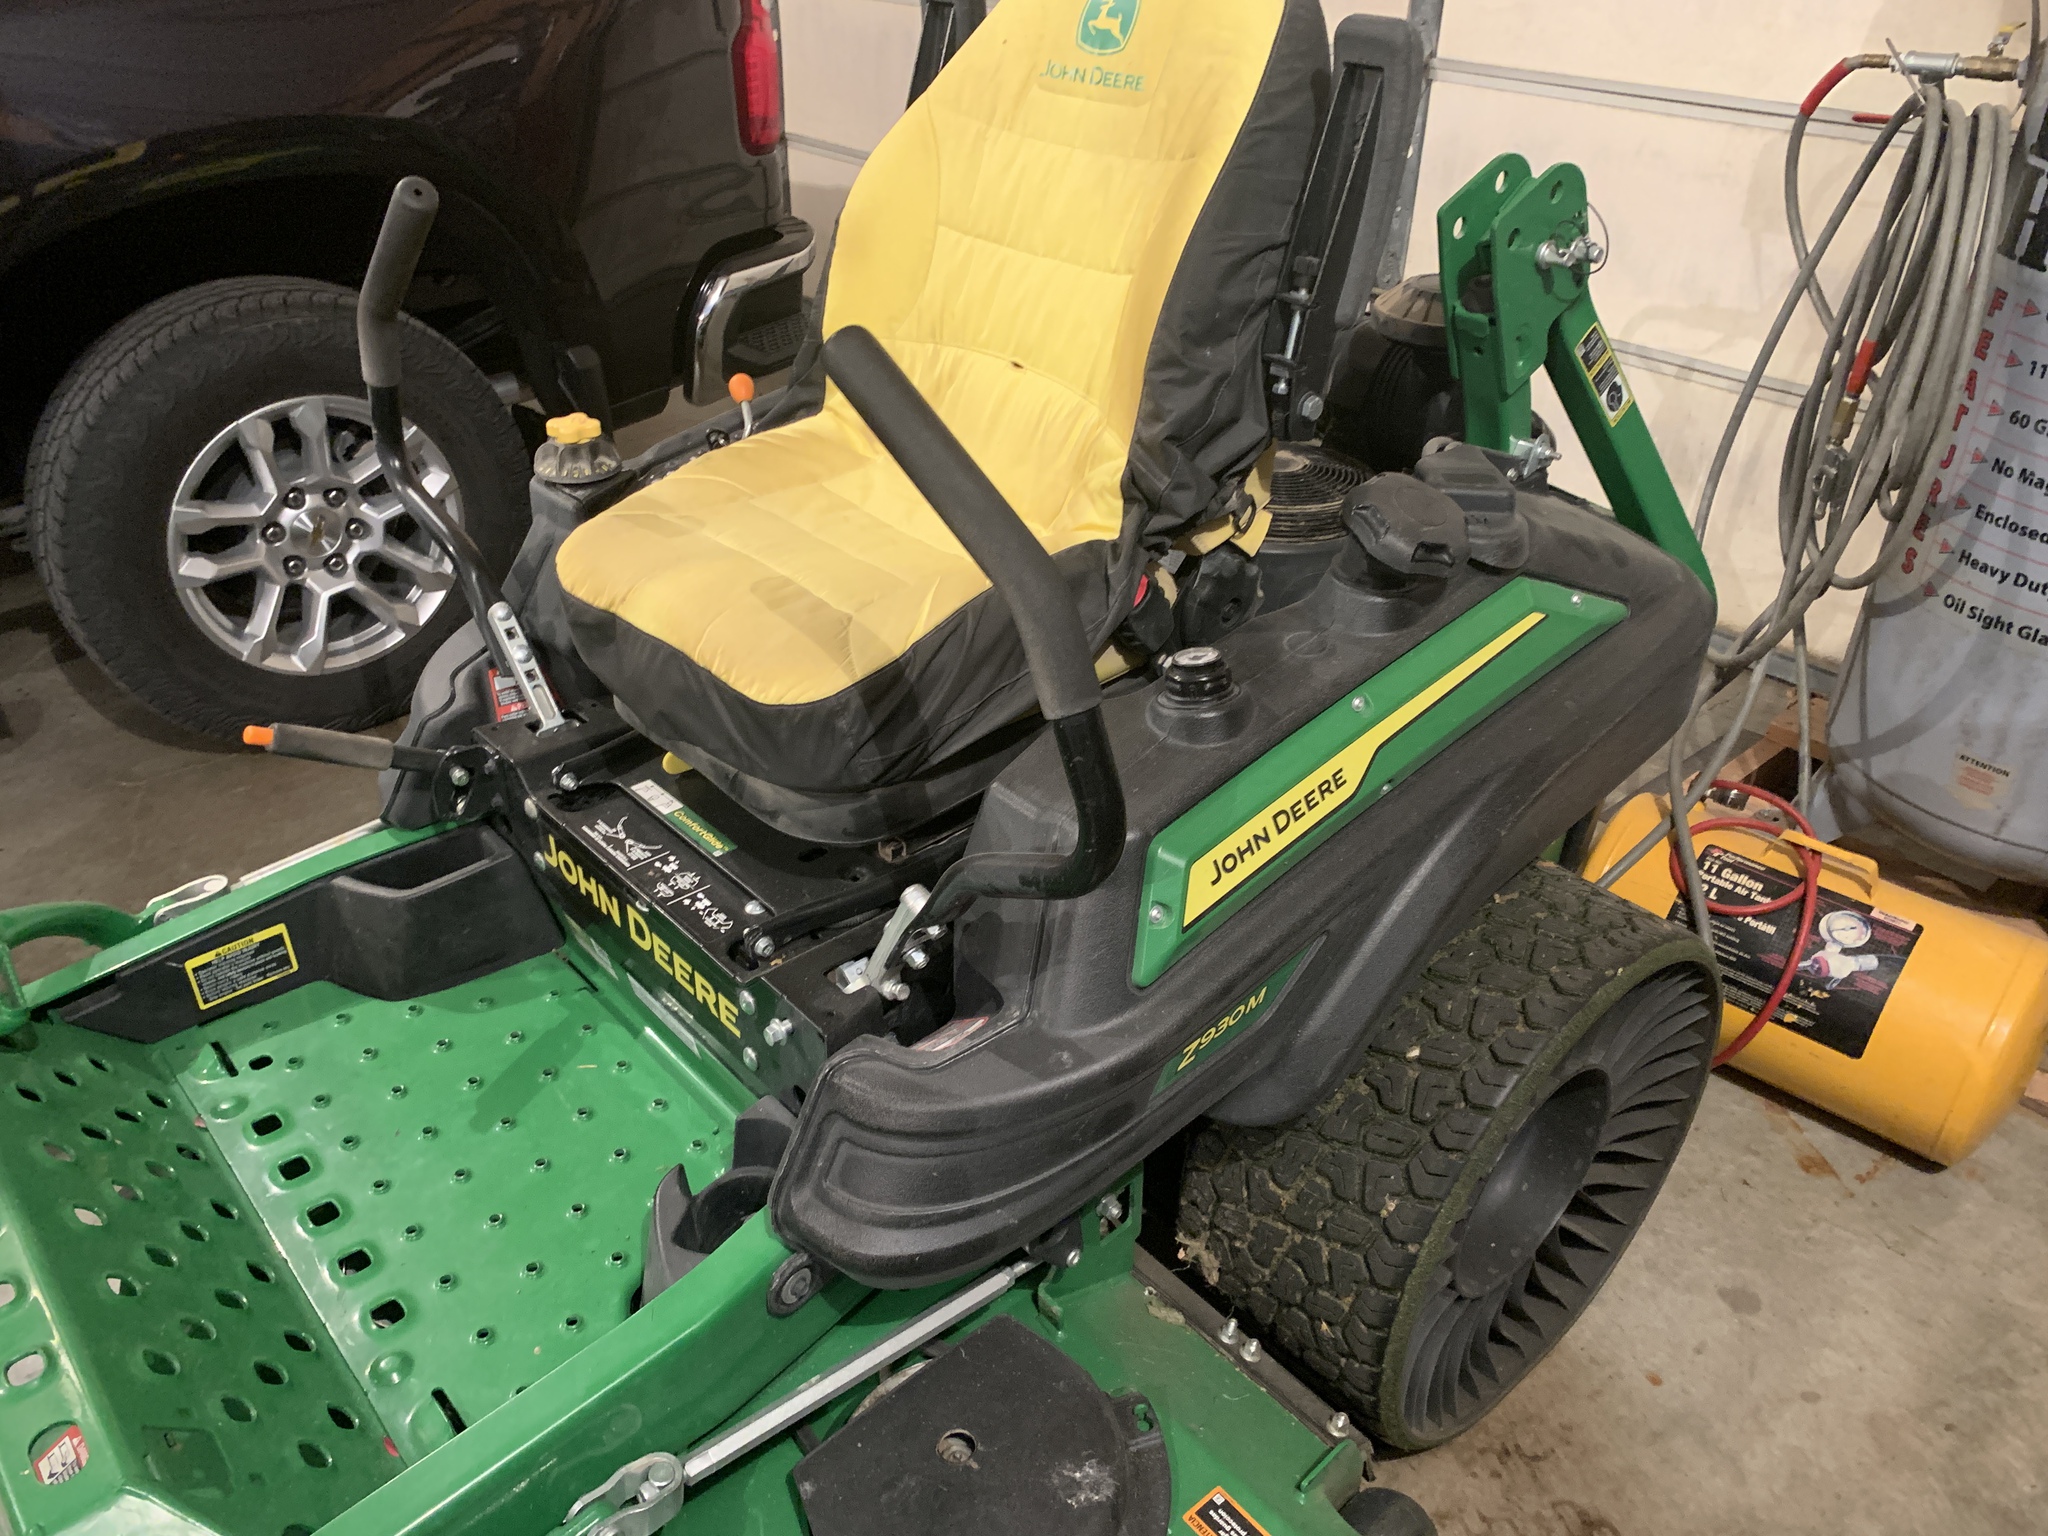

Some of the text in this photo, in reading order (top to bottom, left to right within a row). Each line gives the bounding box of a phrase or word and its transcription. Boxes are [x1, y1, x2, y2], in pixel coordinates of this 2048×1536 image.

[1040, 59, 1146, 91] JOHN DEERE
[2009, 410, 2048, 437] 60 G
[1991, 457, 2014, 478] No
[1958, 549, 2048, 602] Heavy Dut
[1943, 594, 1966, 614] Oil
[1967, 605, 2014, 635] Sight
[1959, 754, 2010, 777] ATTENTION
[1210, 768, 1347, 886] JOHN DEERE
[1703, 861, 1764, 892] 11 Gallon
[1734, 886, 1749, 896] Air
[221, 938, 254, 954] CAUTION
[544, 834, 622, 928] JOHN
[626, 903, 741, 1038] DEERE
[1177, 987, 1267, 1072] Z930M
[1188, 1515, 1215, 1536] TENCIA
